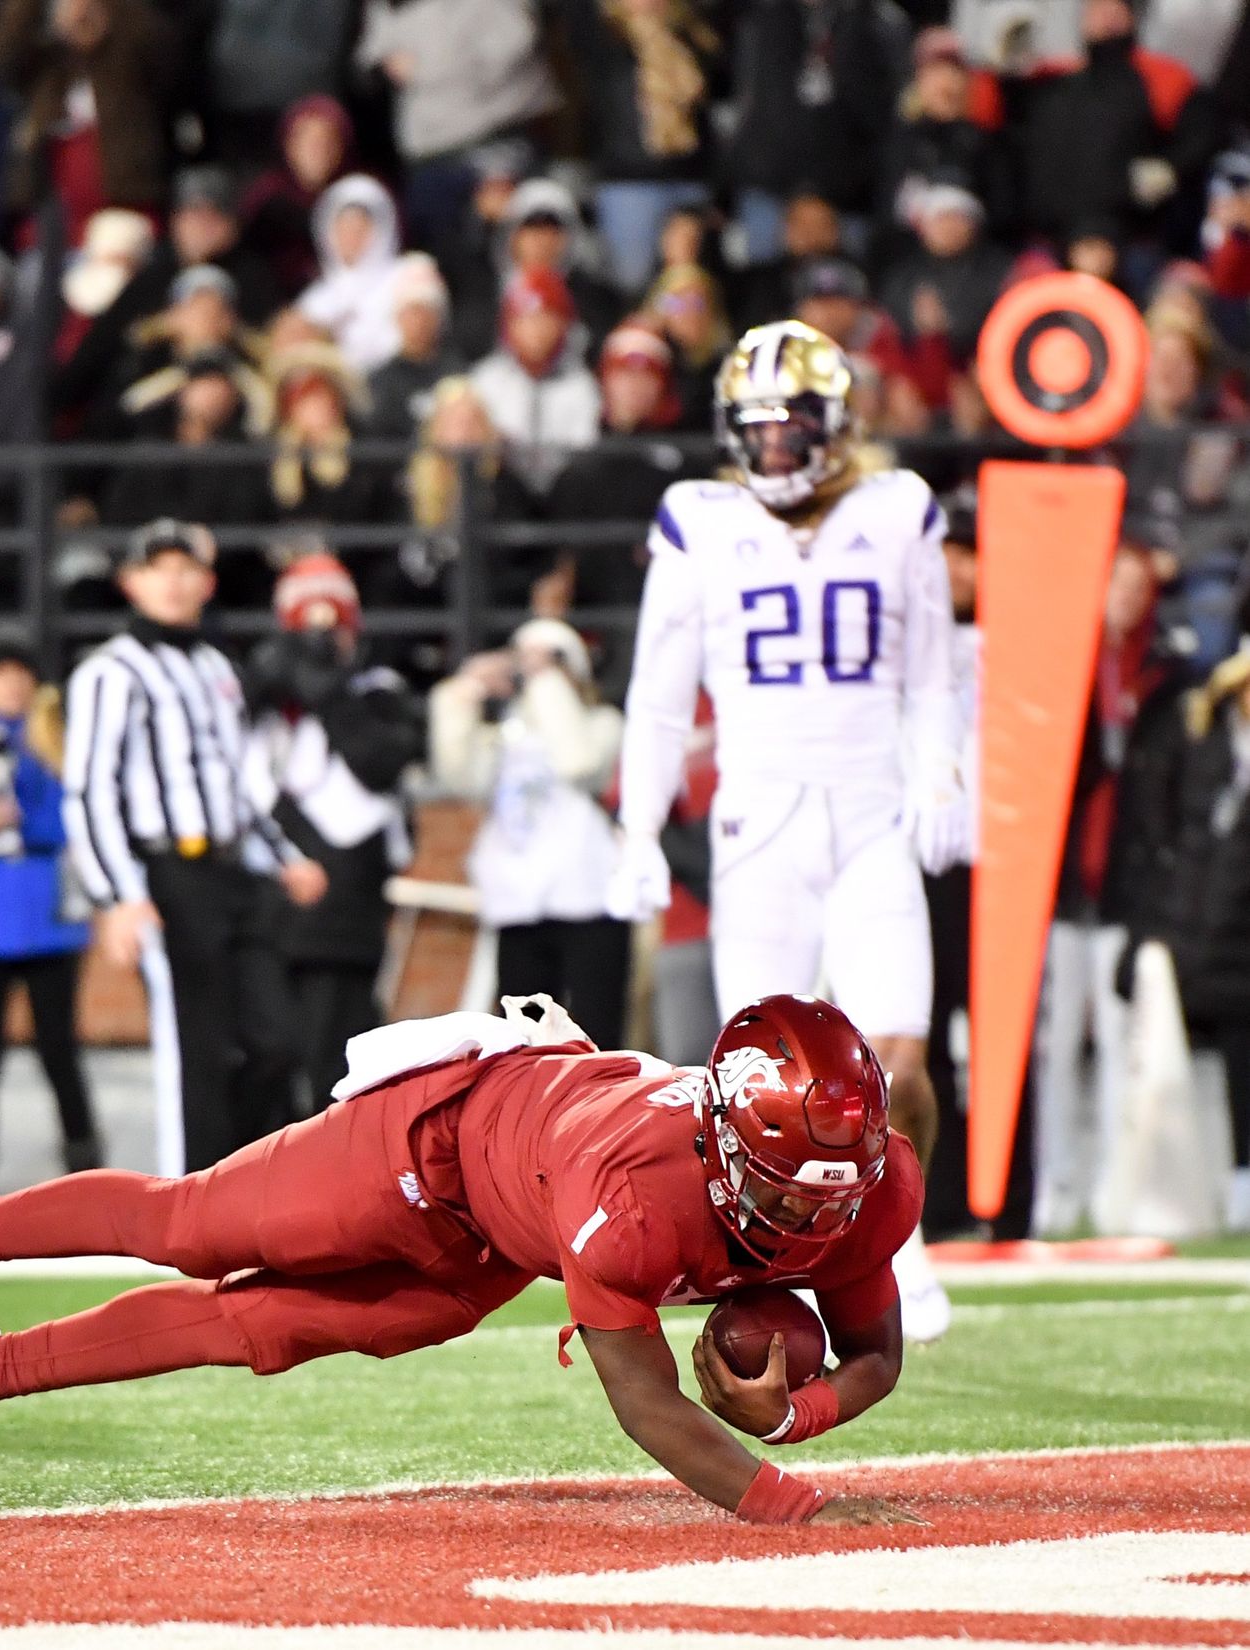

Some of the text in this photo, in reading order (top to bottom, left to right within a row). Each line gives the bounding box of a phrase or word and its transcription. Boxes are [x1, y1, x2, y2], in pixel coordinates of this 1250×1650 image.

[740, 579, 883, 685] 20
[821, 1168, 846, 1181] WSU
[570, 1204, 610, 1255] 1
